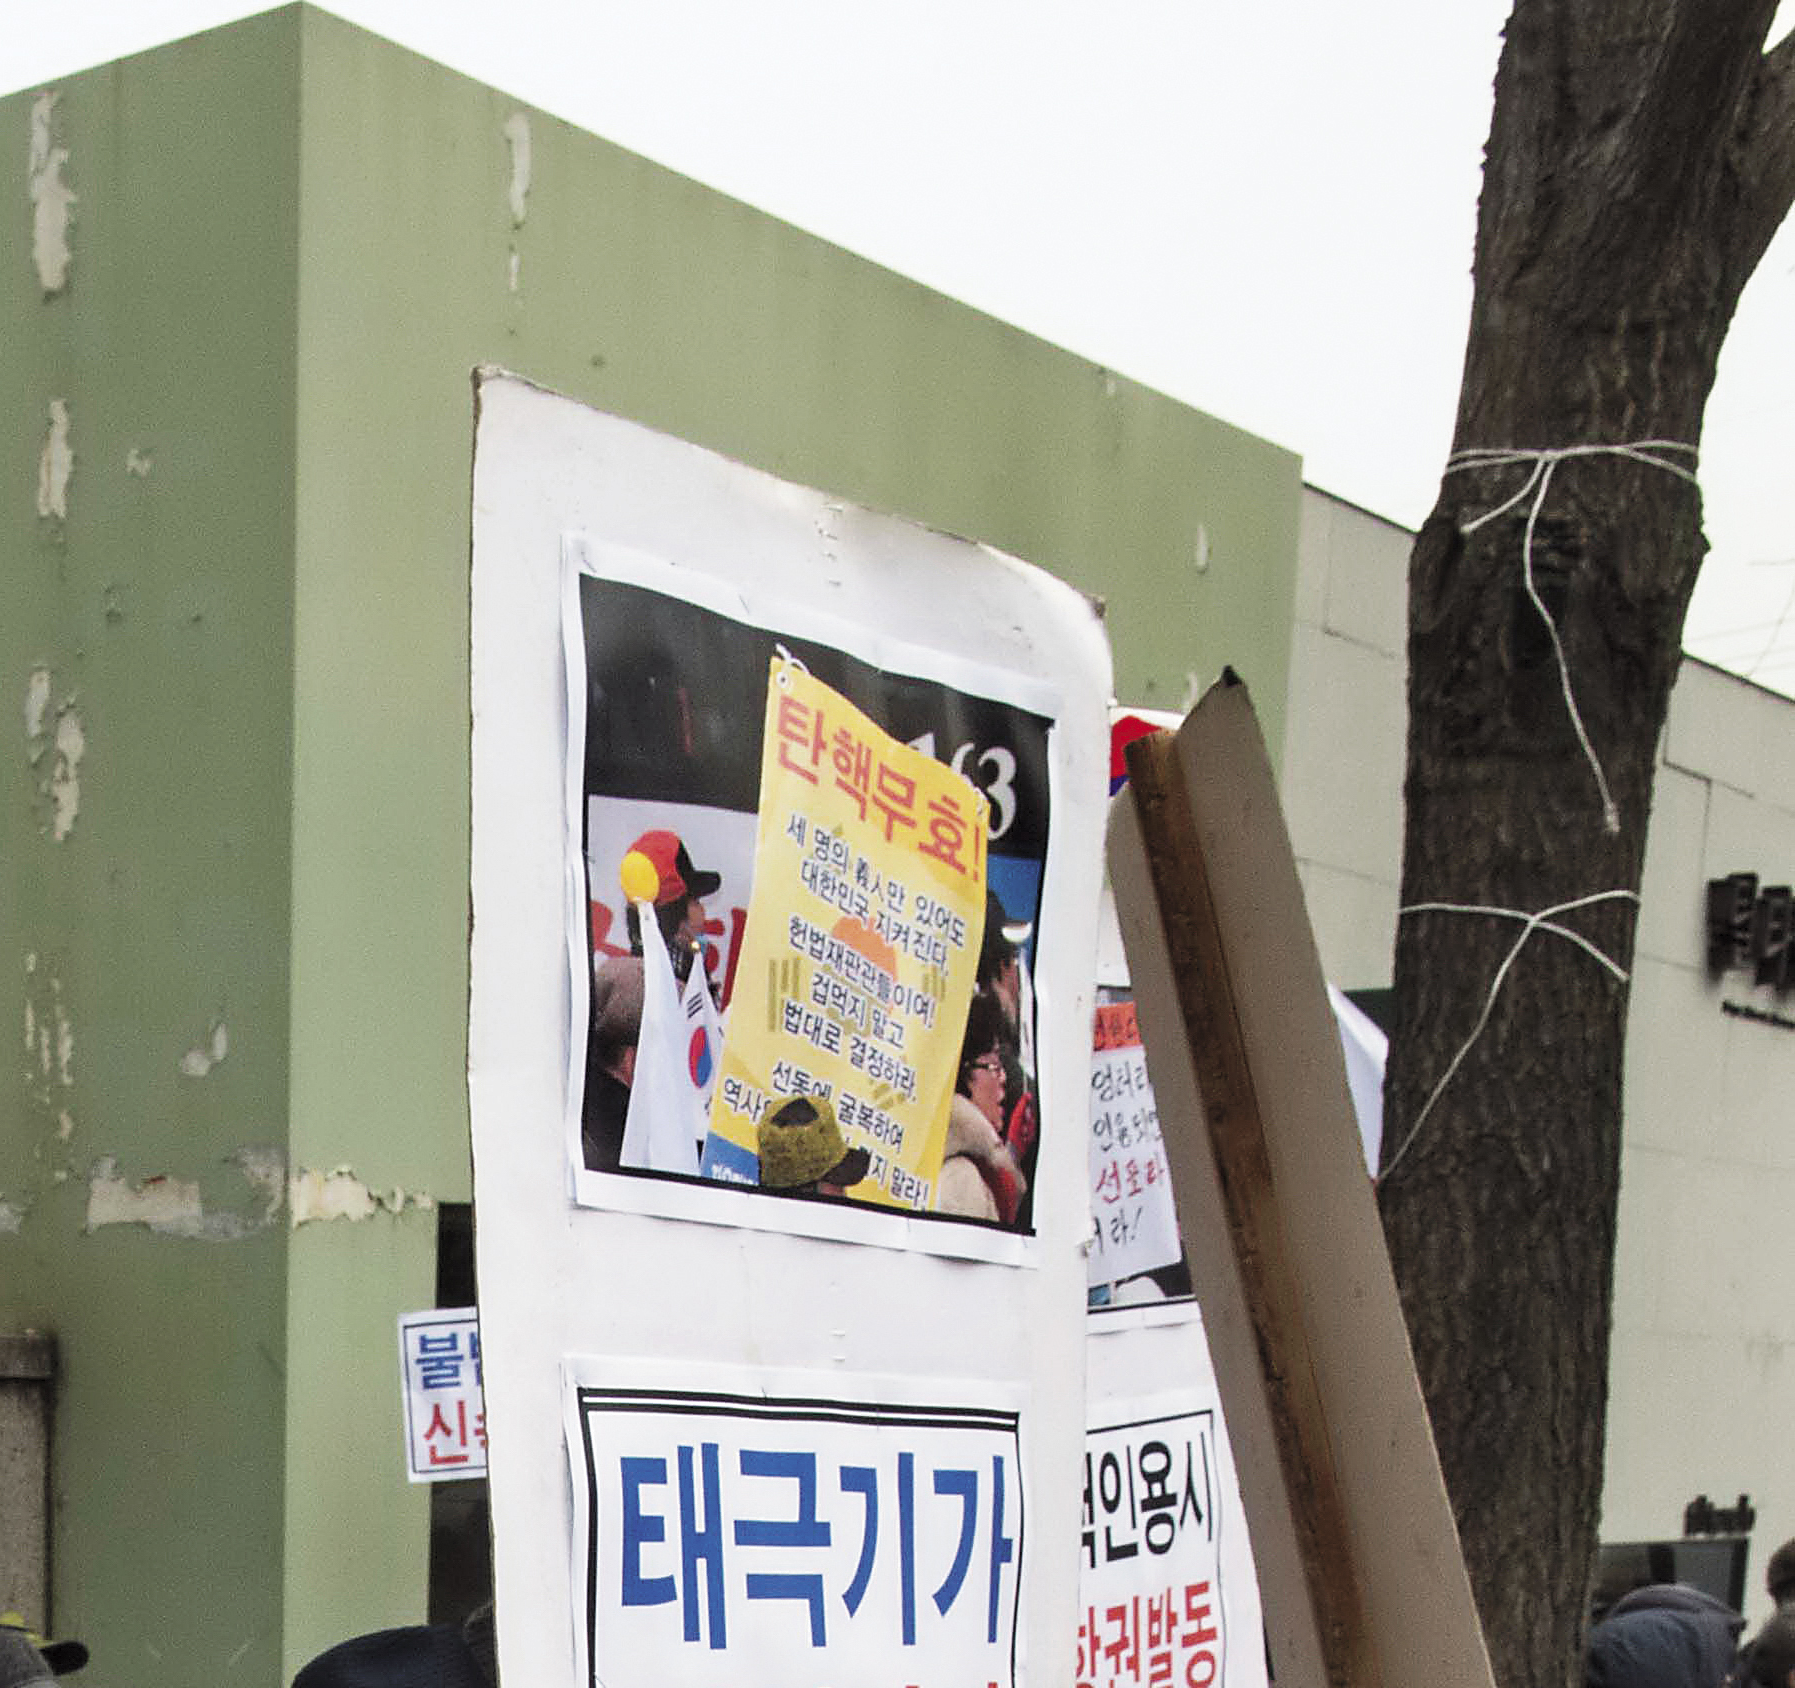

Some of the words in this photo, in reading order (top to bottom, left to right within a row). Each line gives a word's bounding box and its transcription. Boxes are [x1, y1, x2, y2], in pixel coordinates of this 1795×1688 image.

[777, 694, 981, 882] 탄핵무효!
[787, 814, 806, 848] 세
[814, 829, 850, 873] 명의
[916, 895, 965, 947] 있어도
[801, 859, 870, 928] 대한민국
[785, 1001, 841, 1055] 법대로
[812, 973, 866, 1027] 겁먹지
[872, 1008, 904, 1049] 말고
[724, 1078, 772, 1122] 역사
[838, 1092, 904, 1153] 굴복하여
[892, 1166, 930, 1210] 말라!
[415, 1331, 480, 1389] 불
[423, 1400, 486, 1464] 신
[620, 1443, 1013, 1650] 태극기가
